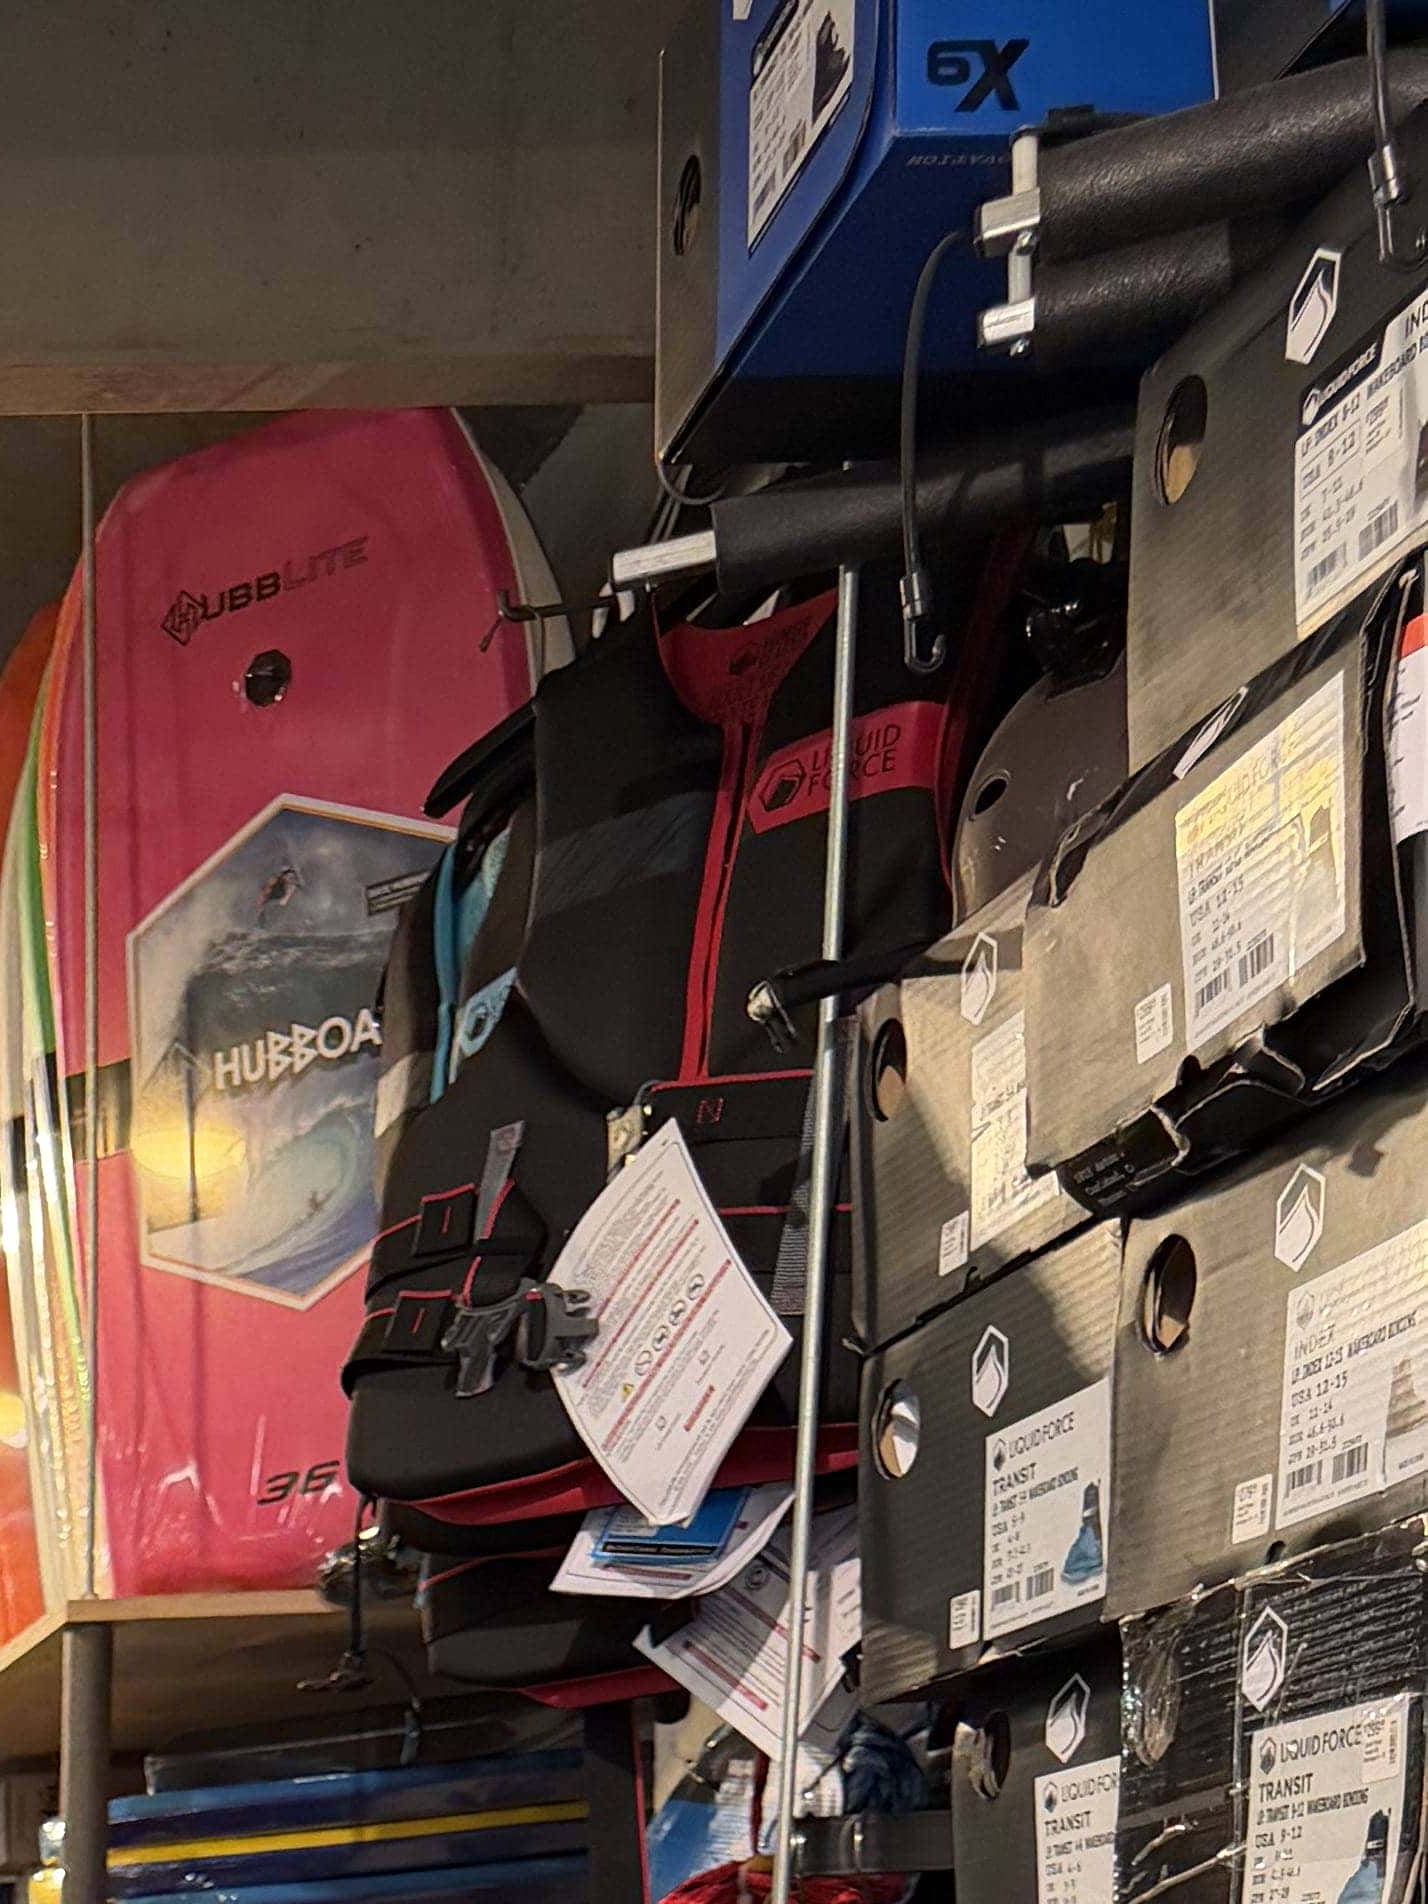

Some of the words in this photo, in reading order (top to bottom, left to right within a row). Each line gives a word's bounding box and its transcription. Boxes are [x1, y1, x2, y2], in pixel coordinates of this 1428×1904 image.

[813, 724, 901, 771] LIUID
[1290, 1384, 1313, 1409] USA
[1315, 1368, 1348, 1400] 12-15
[257, 1459, 340, 1506] 36
[992, 1461, 1037, 1497] TRANSIT
[1321, 1721, 1363, 1754] FORCE
[1257, 1770, 1314, 1804] TRANSIT
[1044, 1809, 1091, 1837] TRANSIT
[1254, 1830, 1276, 1850] USA
[1279, 1824, 1303, 1843] 9-12
